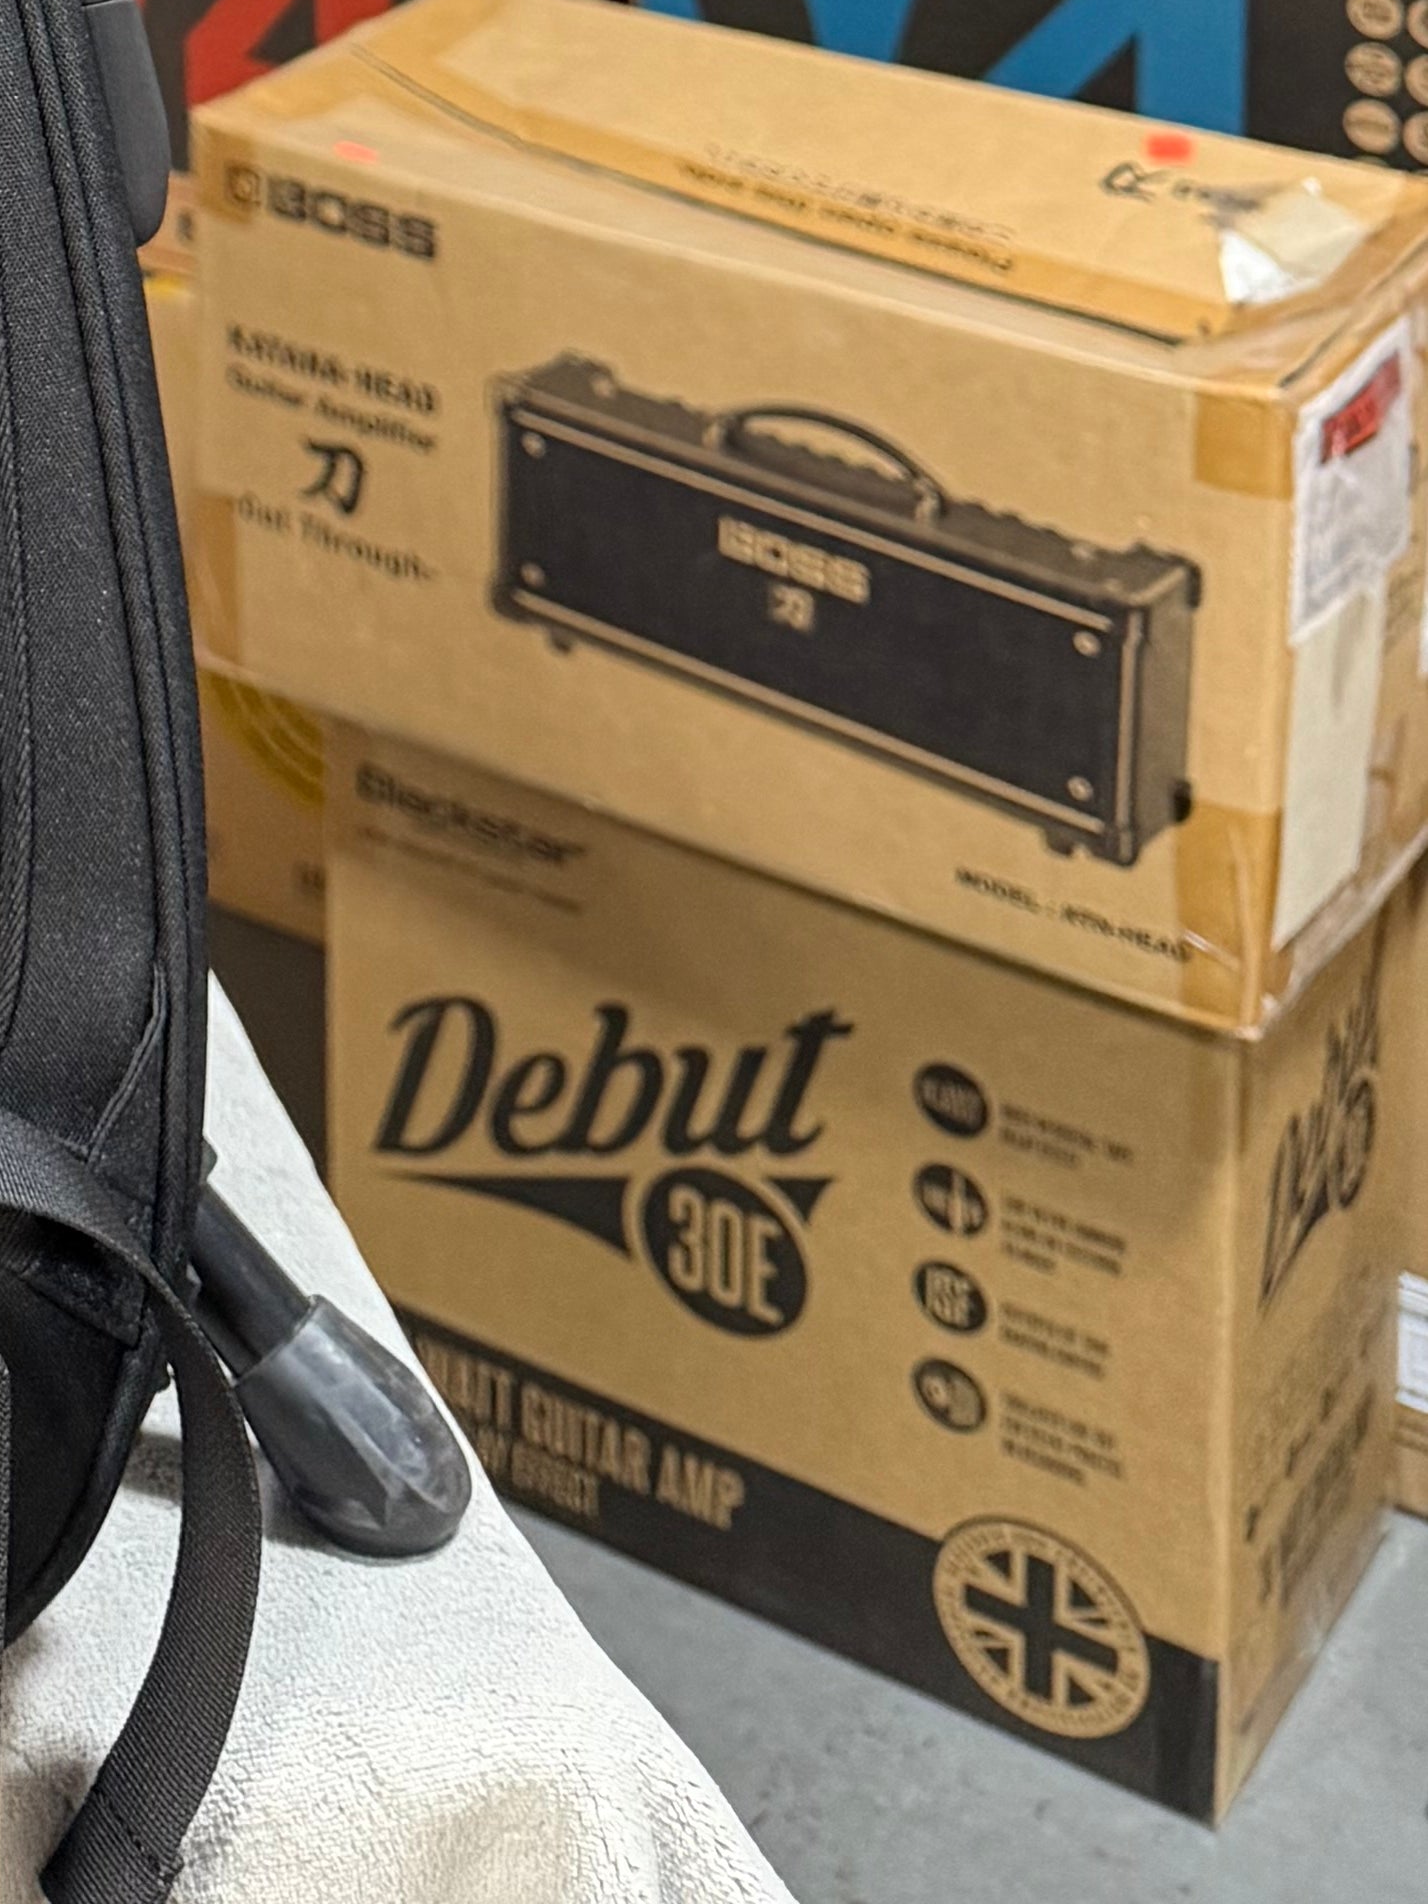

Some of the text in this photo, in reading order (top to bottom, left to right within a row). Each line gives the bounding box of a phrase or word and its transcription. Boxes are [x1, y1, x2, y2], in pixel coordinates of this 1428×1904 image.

[267, 173, 437, 263] BOSS
[718, 515, 872, 605] BOSS
[372, 994, 855, 1159] Debut
[668, 1183, 784, 1326] 30E
[657, 1442, 745, 1532] AMP
